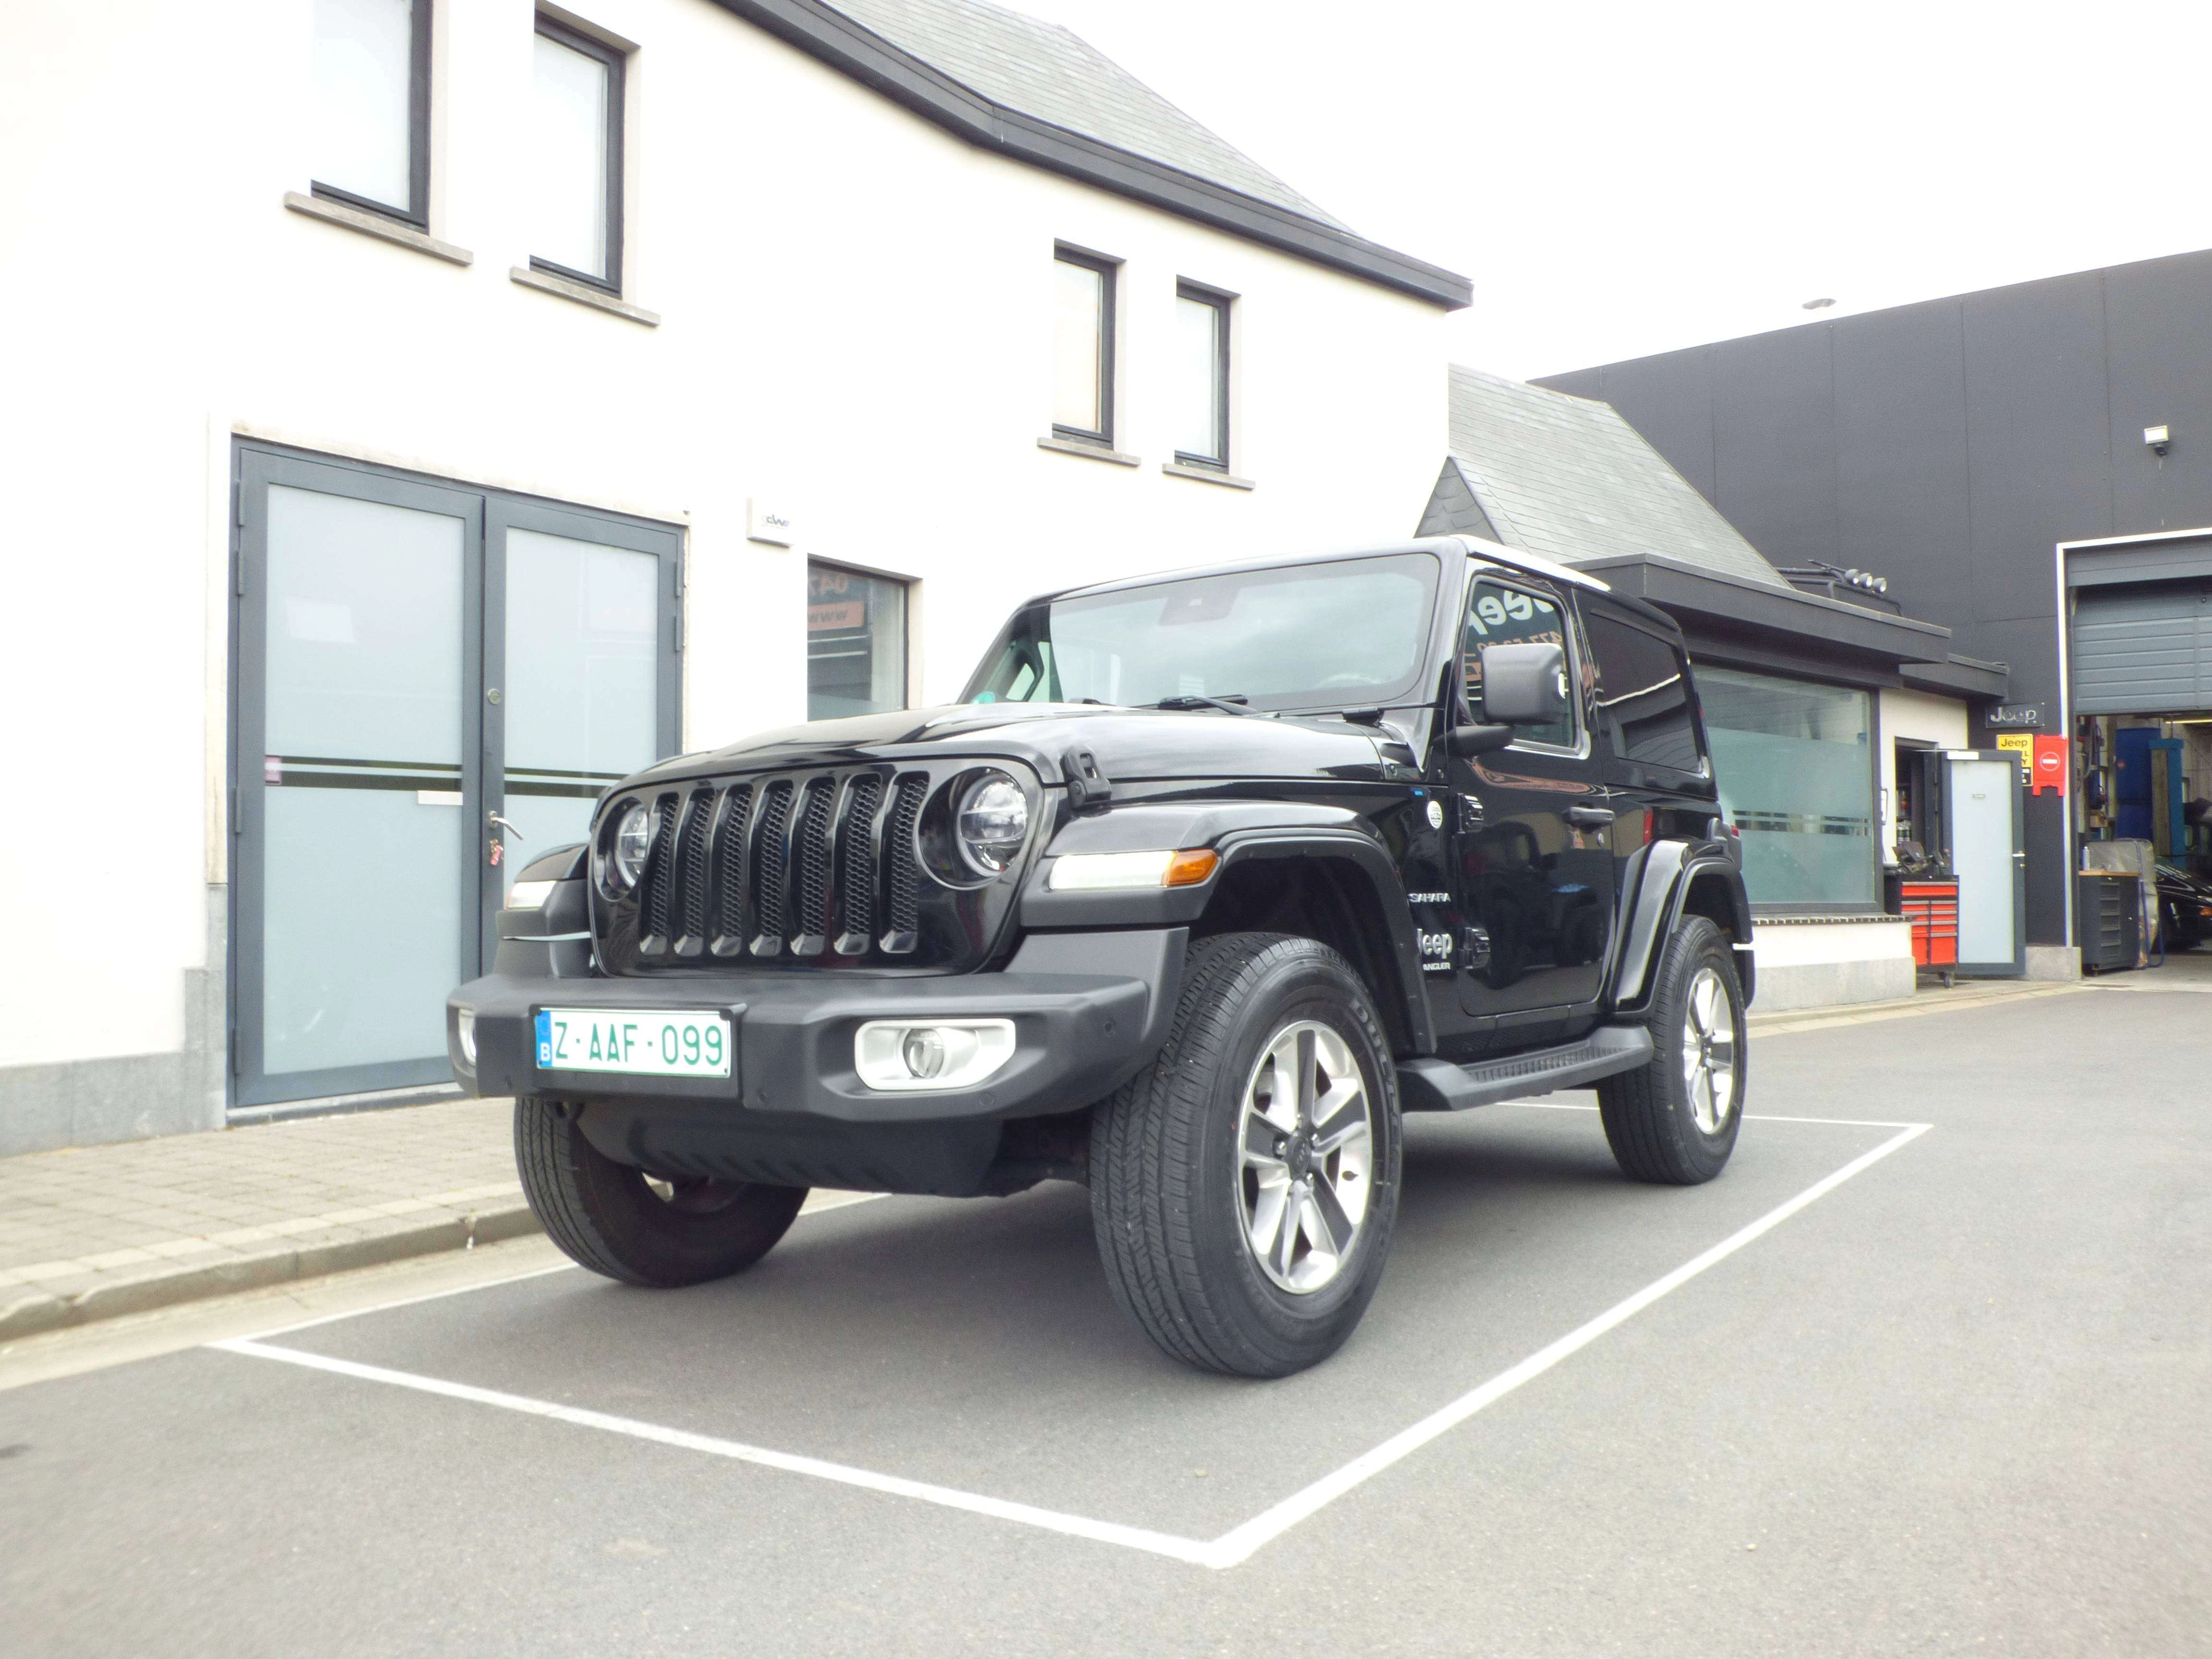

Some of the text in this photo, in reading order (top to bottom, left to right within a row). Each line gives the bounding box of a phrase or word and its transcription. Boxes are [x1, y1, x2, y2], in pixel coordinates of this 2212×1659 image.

[2001, 738, 2028, 747] Jeep
[1408, 892, 1451, 902] SAHARA
[540, 1043, 551, 1061] B
